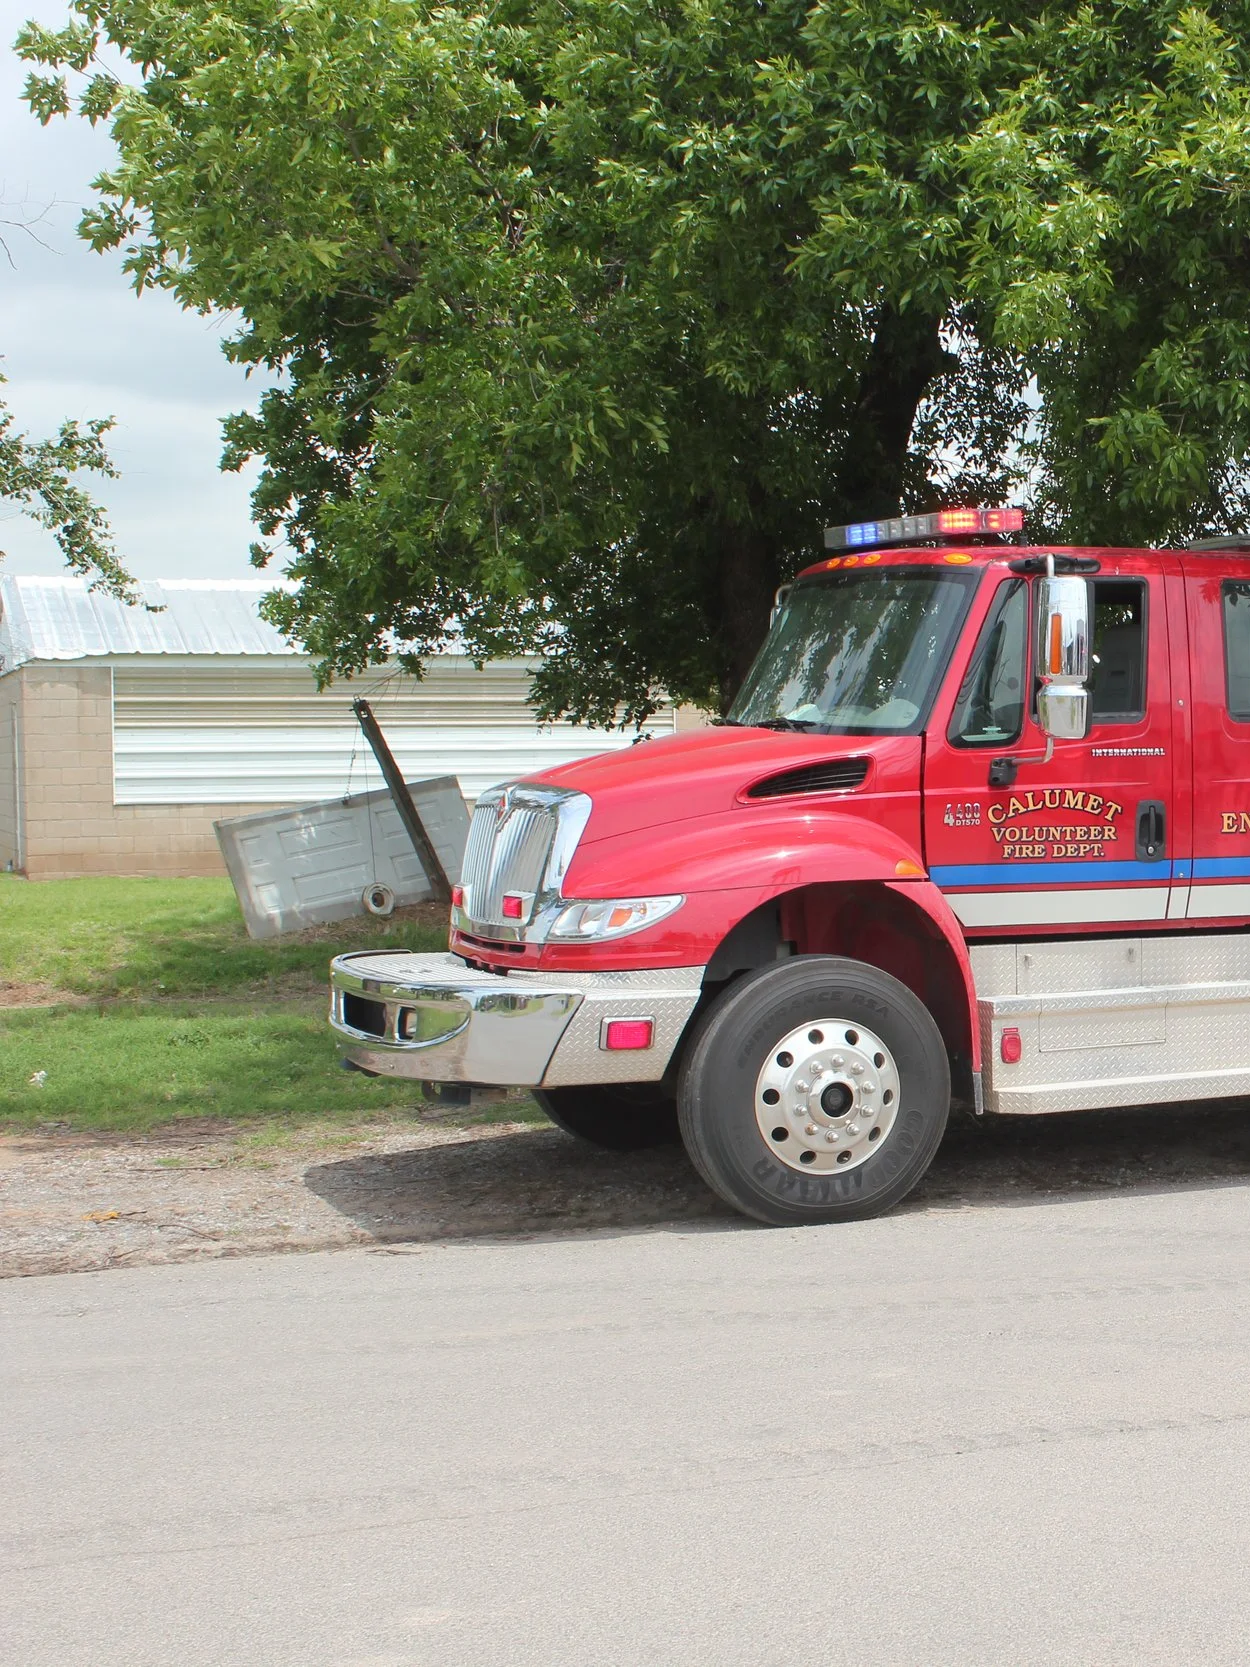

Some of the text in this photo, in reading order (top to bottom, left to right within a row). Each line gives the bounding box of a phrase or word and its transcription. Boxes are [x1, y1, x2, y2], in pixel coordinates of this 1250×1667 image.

[1091, 747, 1166, 757] INTERNATIONAL
[986, 789, 1123, 825] CALUMET
[991, 826, 1118, 842] VOLUNTEER
[1002, 843, 1105, 859] FIRE DEPT.
